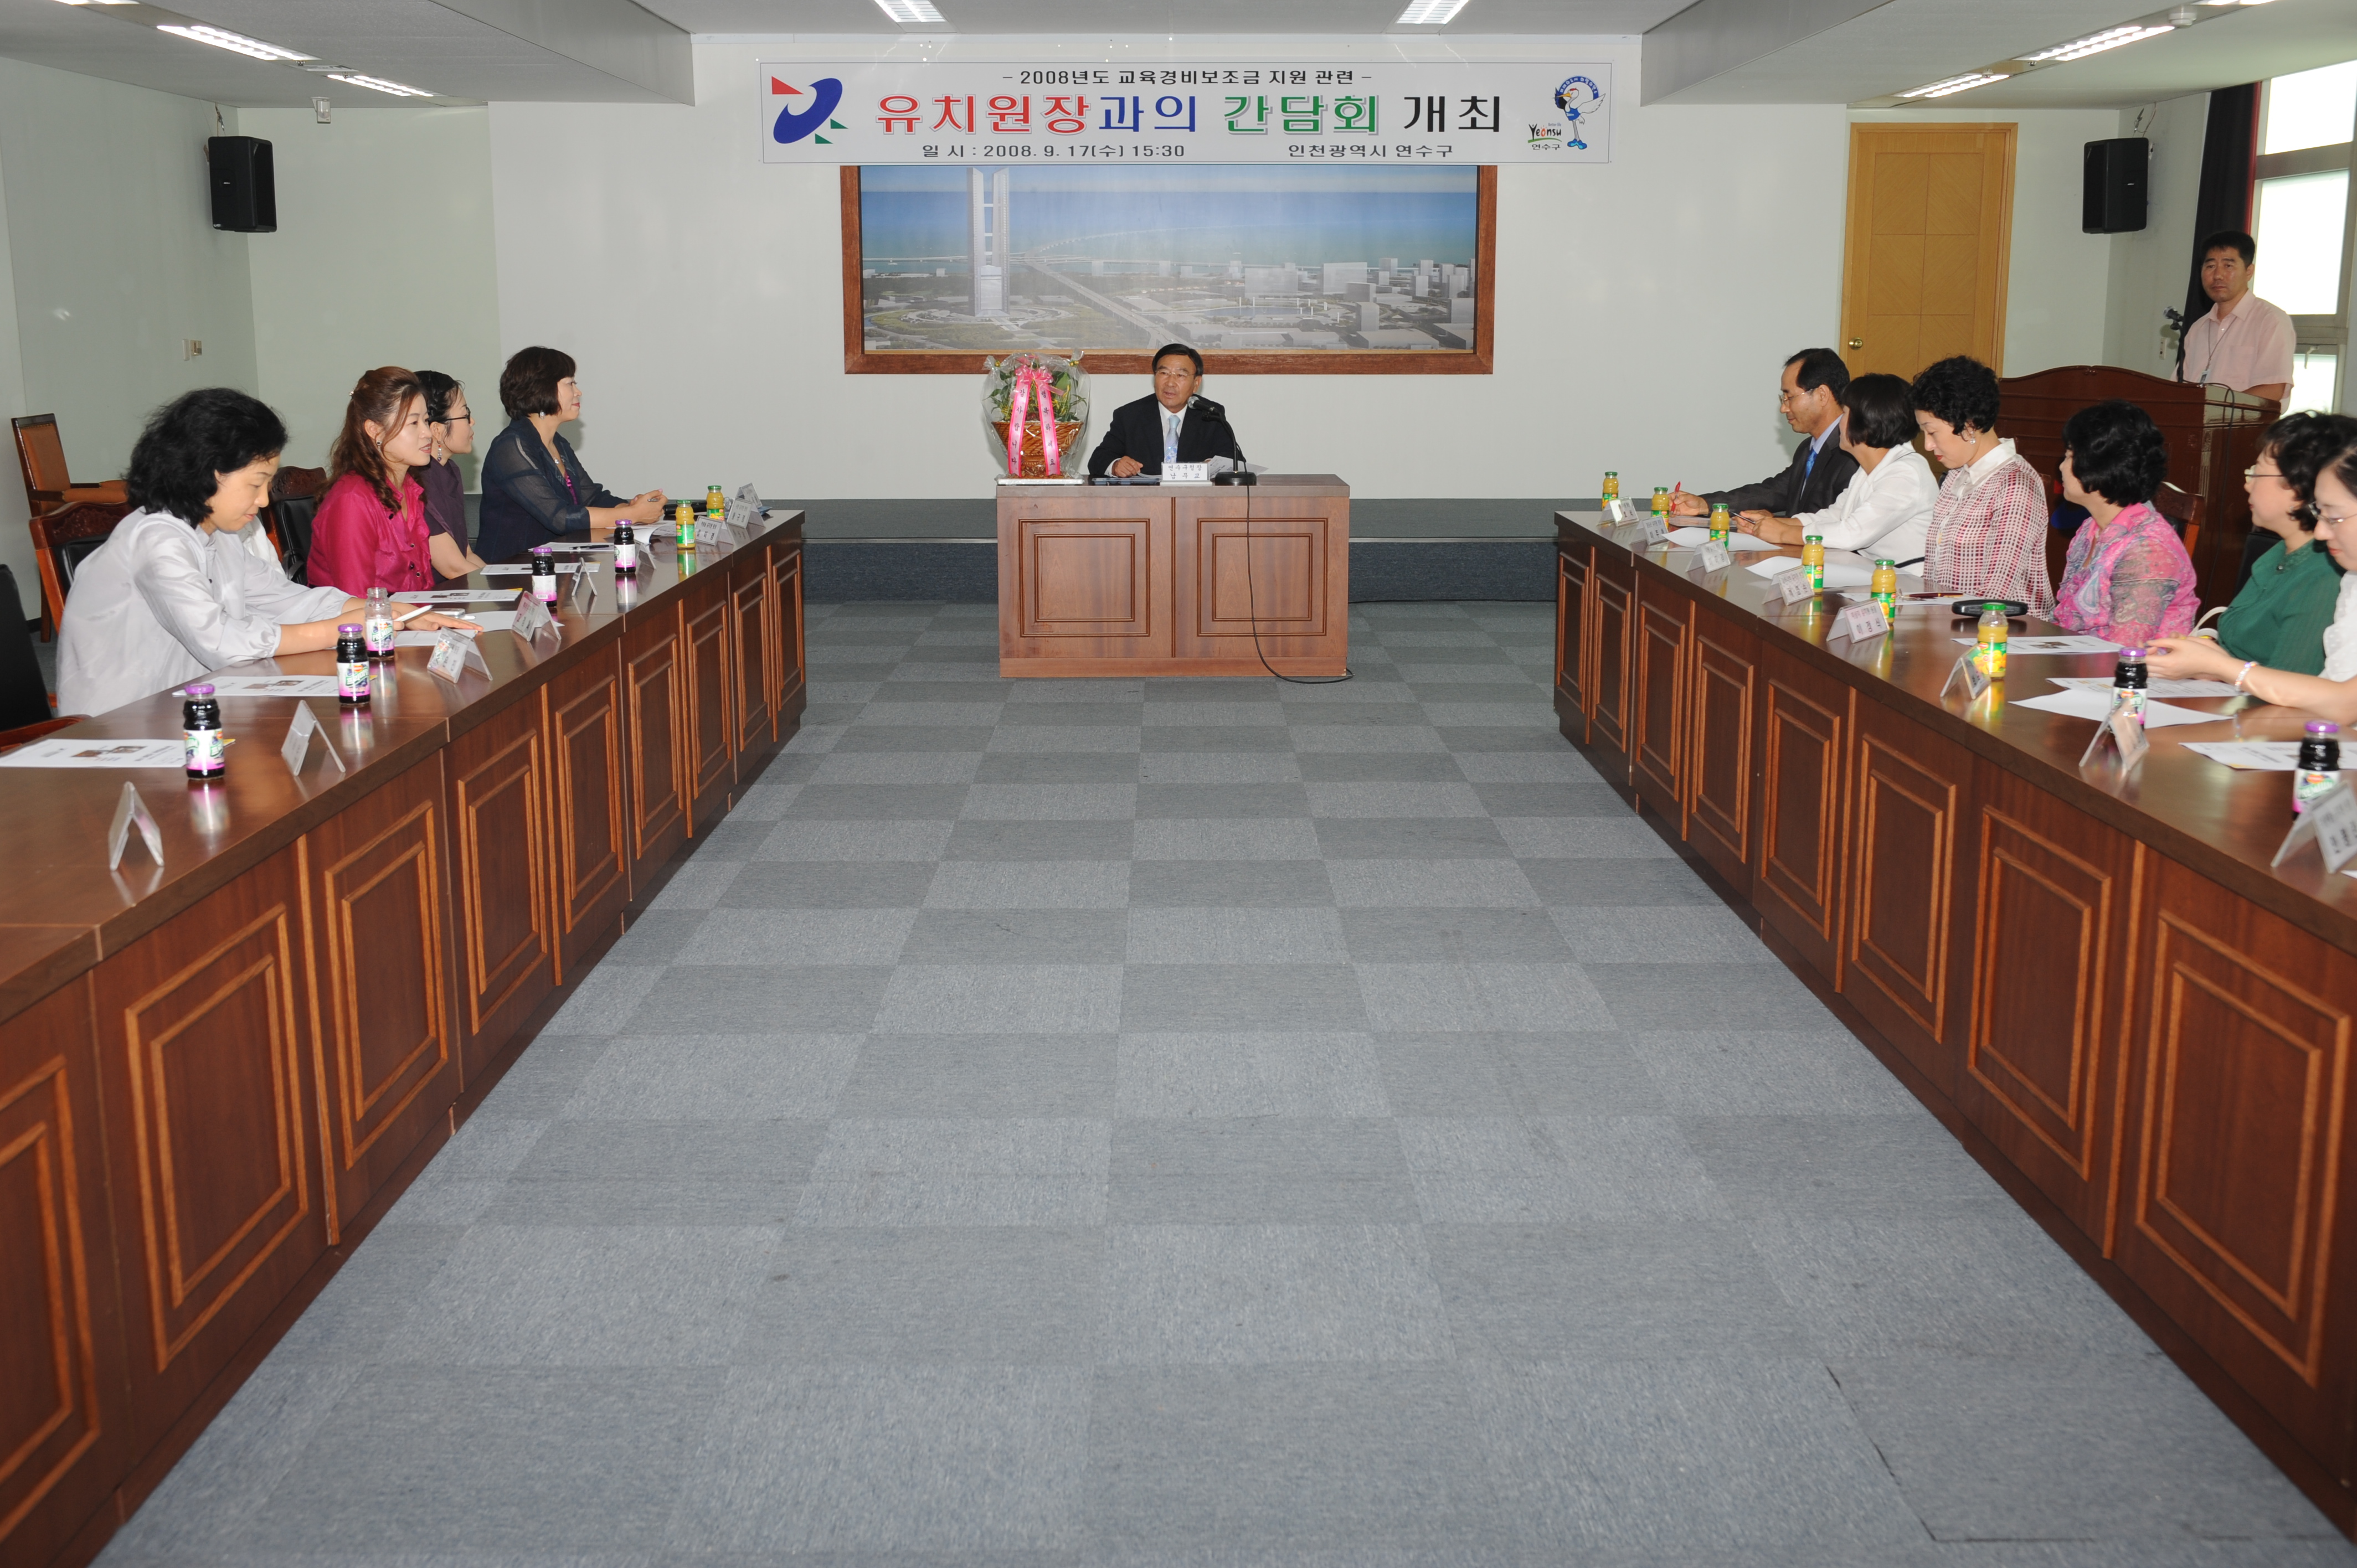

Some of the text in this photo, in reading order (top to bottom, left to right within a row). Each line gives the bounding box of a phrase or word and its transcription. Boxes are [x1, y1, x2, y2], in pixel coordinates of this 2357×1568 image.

[1020, 70, 1109, 85] 2008년도
[1118, 70, 1260, 85] 교육경비보조금
[1269, 70, 1306, 85] 지원
[1315, 70, 1352, 85] 관련
[876, 94, 1500, 135] 유치원장과의 간담회 개최
[1529, 123, 1562, 140] Yeonsu
[1068, 145, 1124, 157] 17(수)
[1133, 145, 1184, 157] 15:30
[1288, 145, 1453, 158] 인천광역시 연수구
